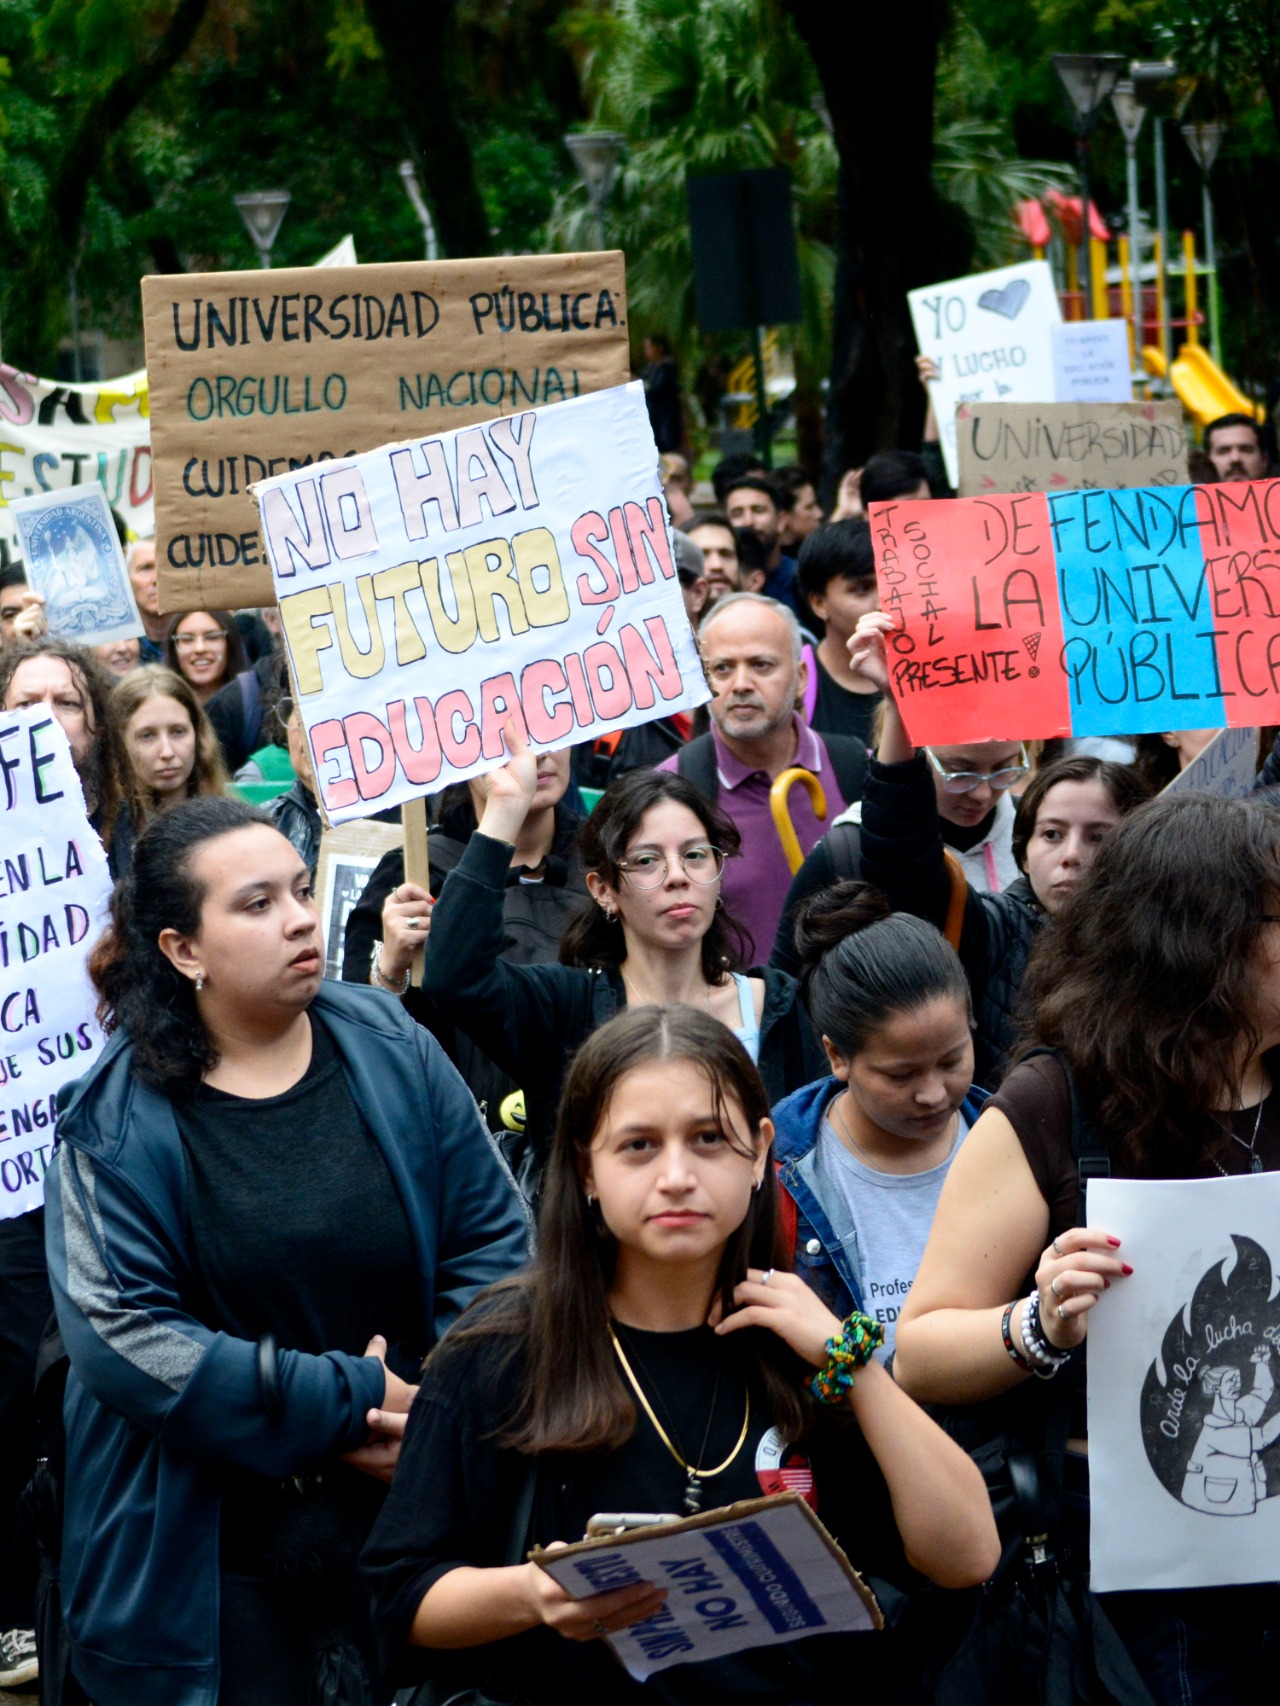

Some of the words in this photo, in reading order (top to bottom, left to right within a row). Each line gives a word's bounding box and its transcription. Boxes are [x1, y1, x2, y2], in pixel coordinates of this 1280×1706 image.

[173, 291, 440, 351] UNIVERSIDAD
[922, 295, 966, 340] YO
[952, 345, 1027, 377] LUCHO
[187, 374, 347, 421] ORGULLO
[972, 416, 1185, 464] UNIVERSIDAD
[261, 466, 380, 577] NO
[389, 412, 540, 542] HAY
[30, 507, 64, 556] UNIVERSIDAD
[65, 507, 107, 540] ARGENTINA
[167, 531, 269, 569] CUIDE
[278, 526, 570, 696] FUTURO
[570, 497, 676, 606] SIN
[873, 505, 916, 655] TRABAJO
[904, 521, 948, 647] SOCIAL
[972, 569, 1046, 632] LA
[308, 605, 683, 811] EDUCACIÓN
[37, 839, 85, 885] LA
[37, 1022, 94, 1067] SUS
[1173, 1357, 1200, 1386] la
[1205, 1314, 1256, 1354] lucha
[659, 1557, 726, 1596] HAY
[695, 1596, 749, 1632] NO
